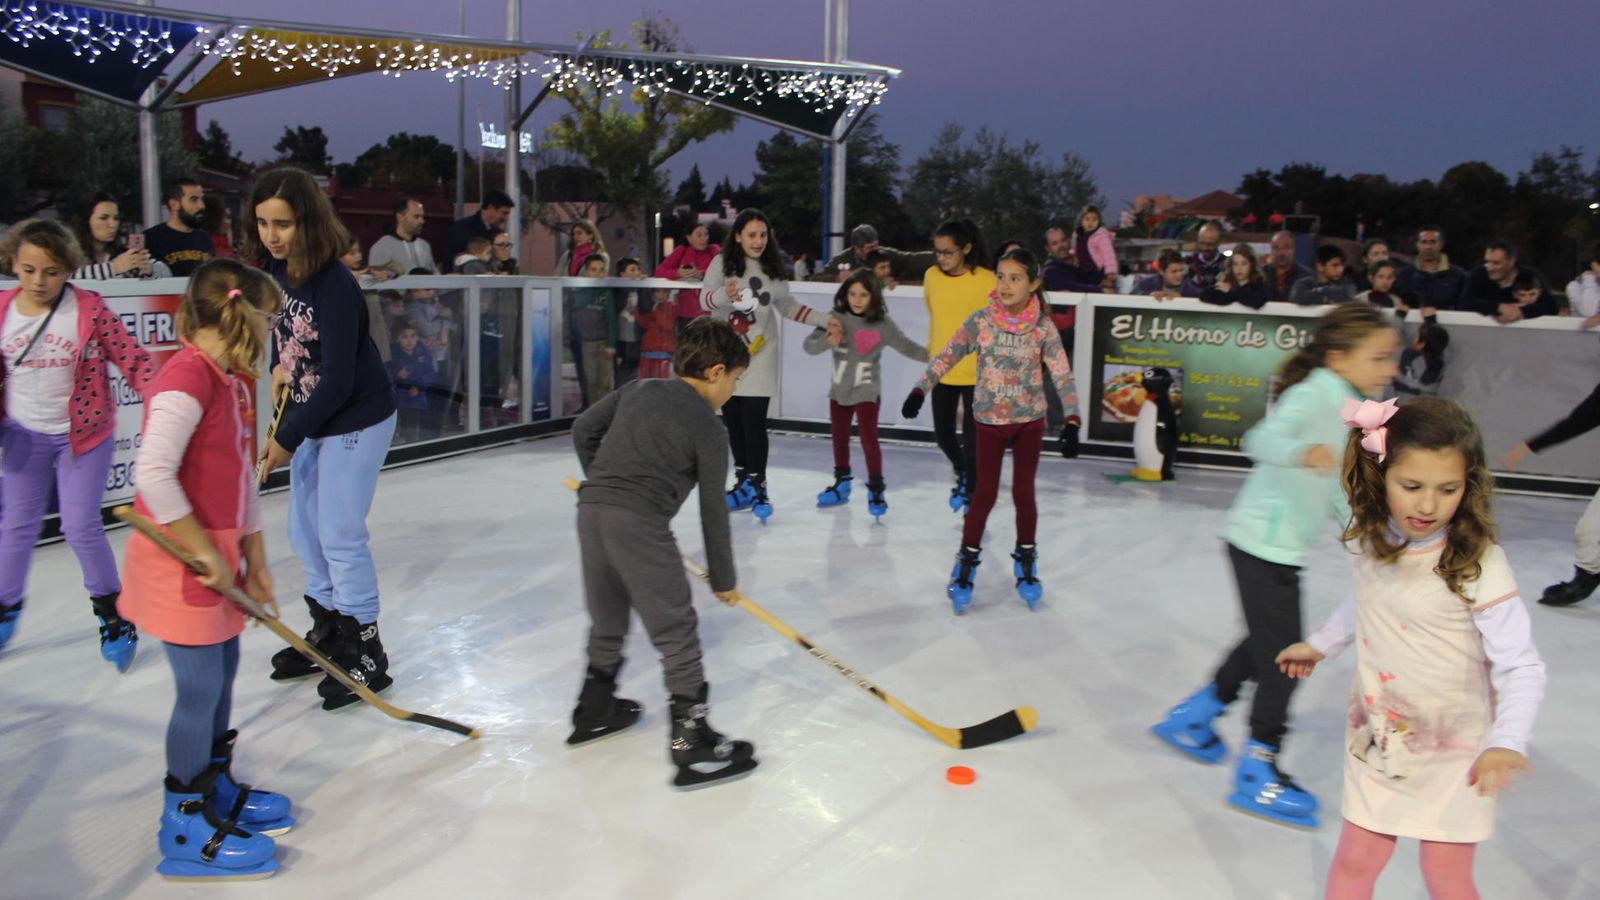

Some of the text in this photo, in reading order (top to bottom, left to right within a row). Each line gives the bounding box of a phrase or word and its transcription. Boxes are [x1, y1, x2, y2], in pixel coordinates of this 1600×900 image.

[141, 311, 177, 345] FR
[1110, 314, 1145, 341] El
[1148, 317, 1229, 346] Horno
[1236, 321, 1266, 348] de
